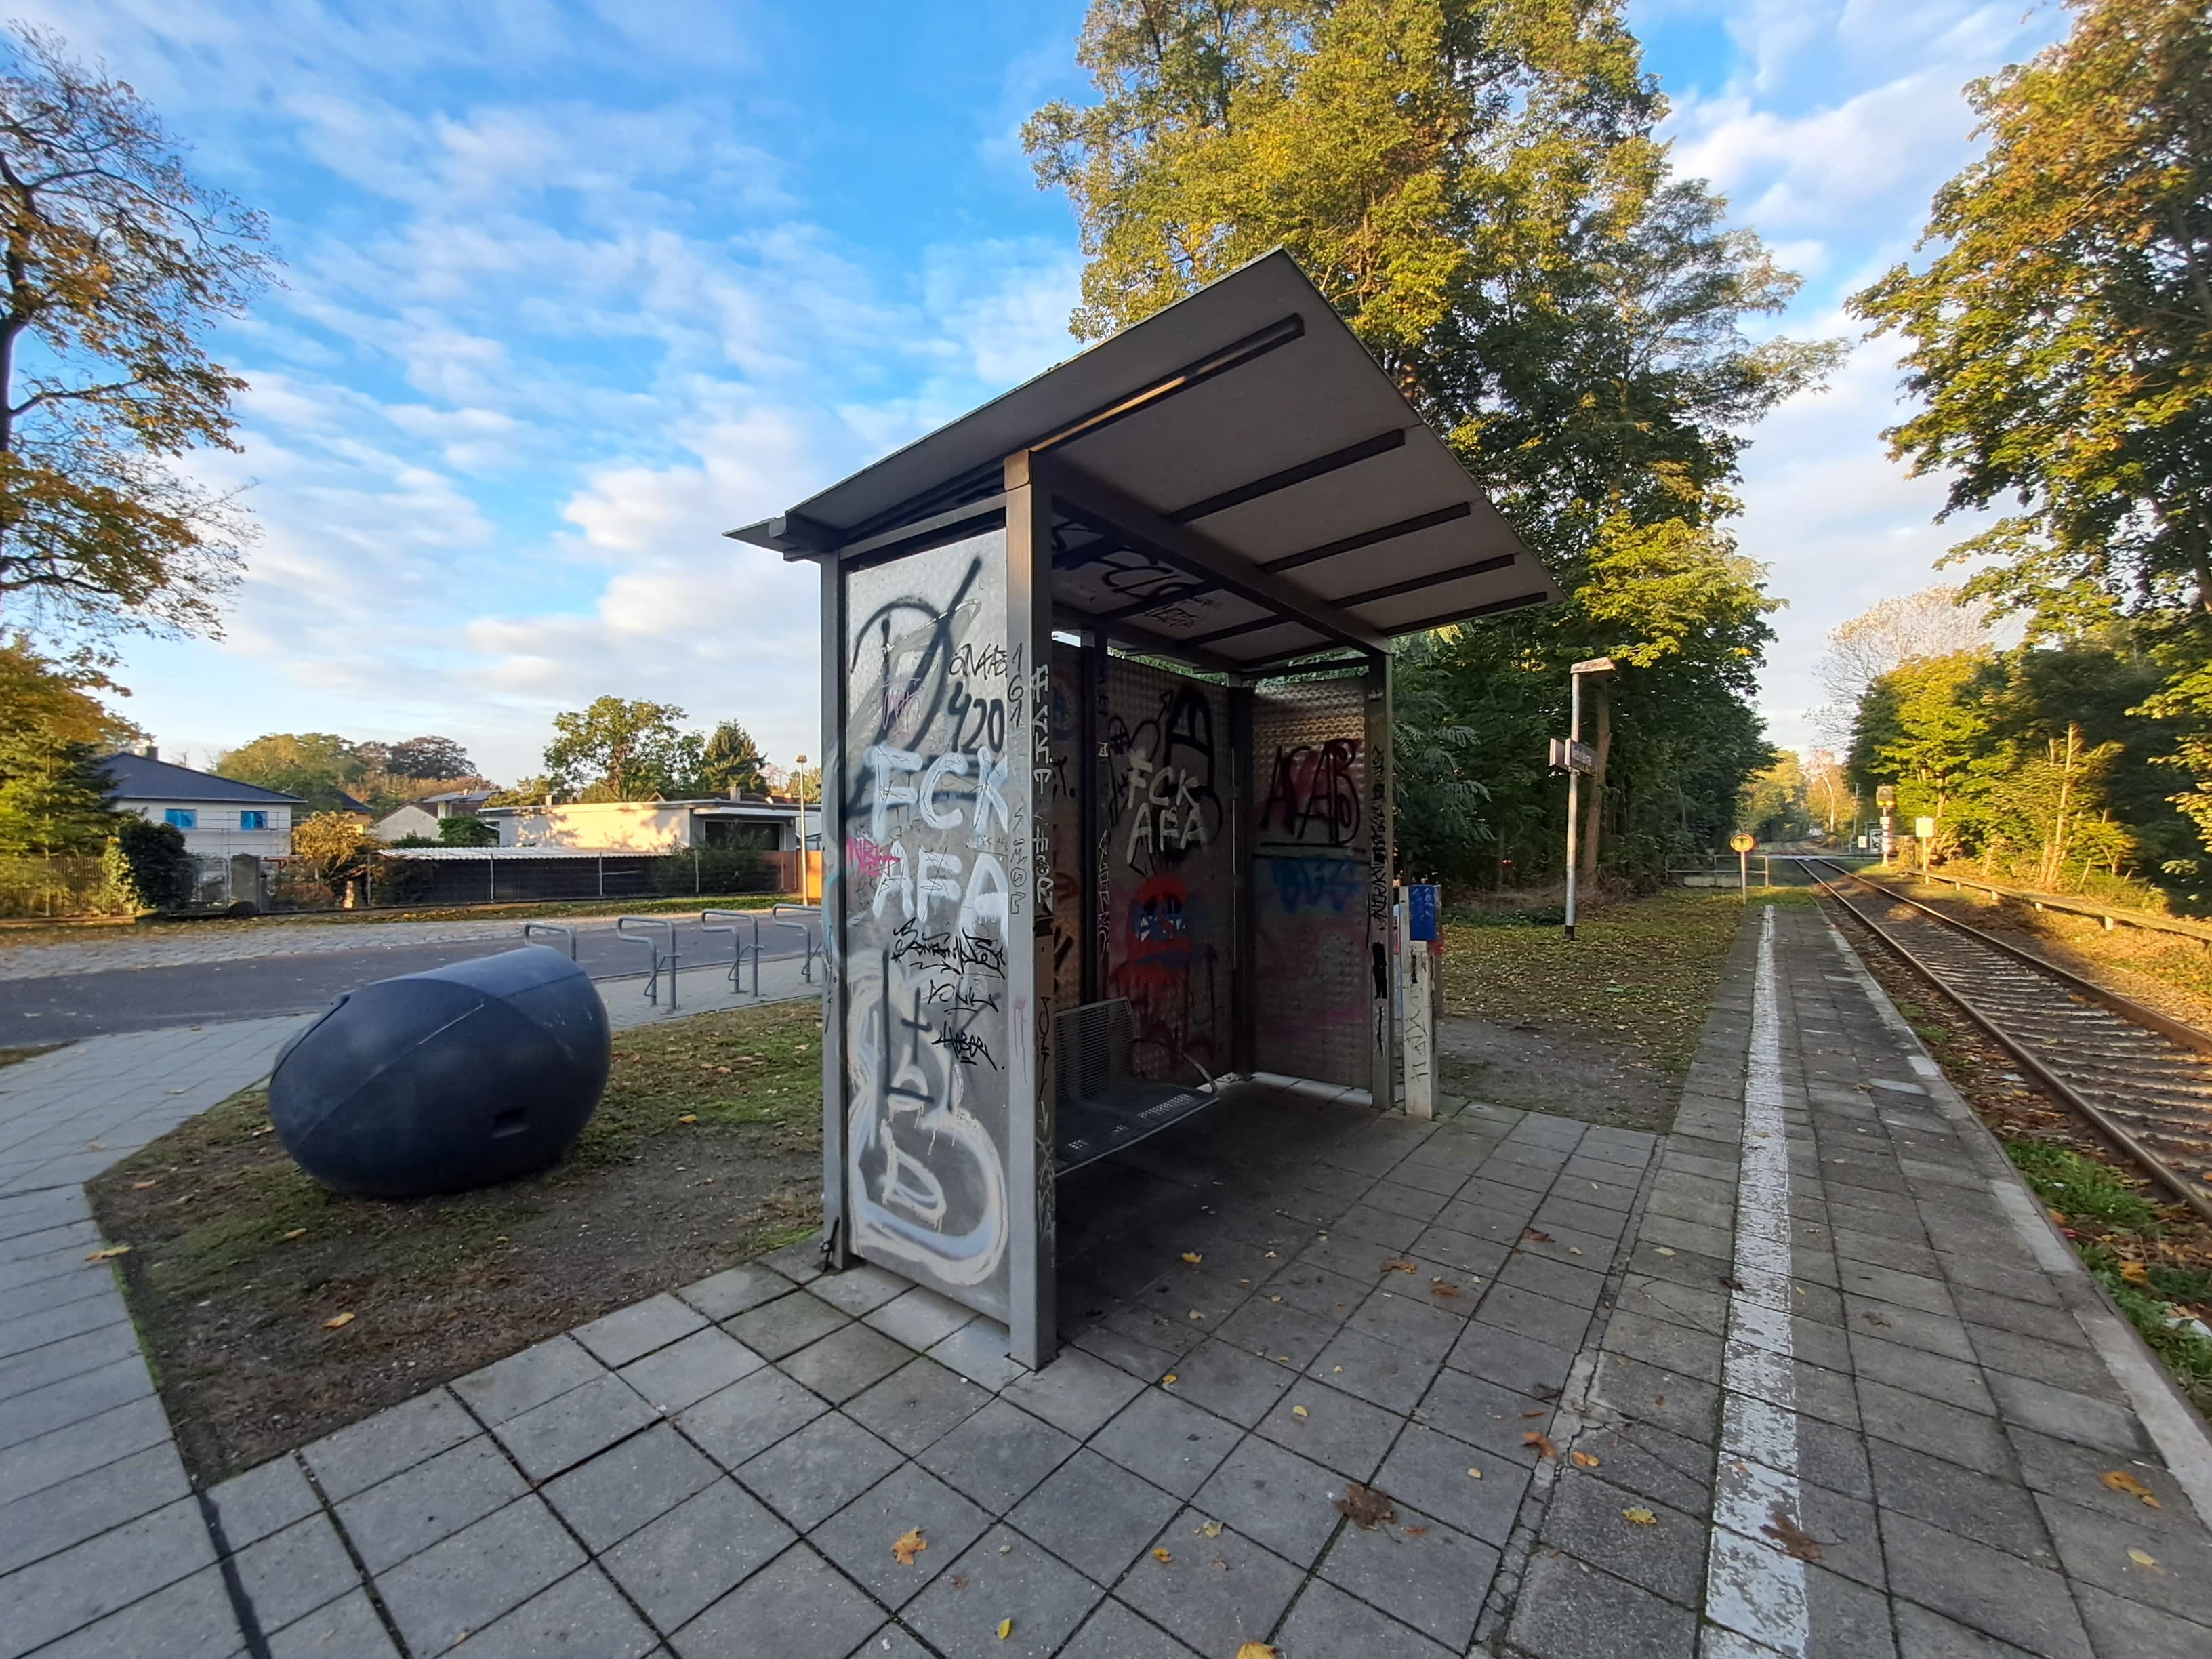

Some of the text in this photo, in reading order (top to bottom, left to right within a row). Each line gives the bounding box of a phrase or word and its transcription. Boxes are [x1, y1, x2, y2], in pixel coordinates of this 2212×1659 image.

[948, 680, 1004, 752] 420
[862, 742, 1008, 843] FCK
[1128, 747, 1200, 811] FCK
[872, 840, 1008, 943] AFA
